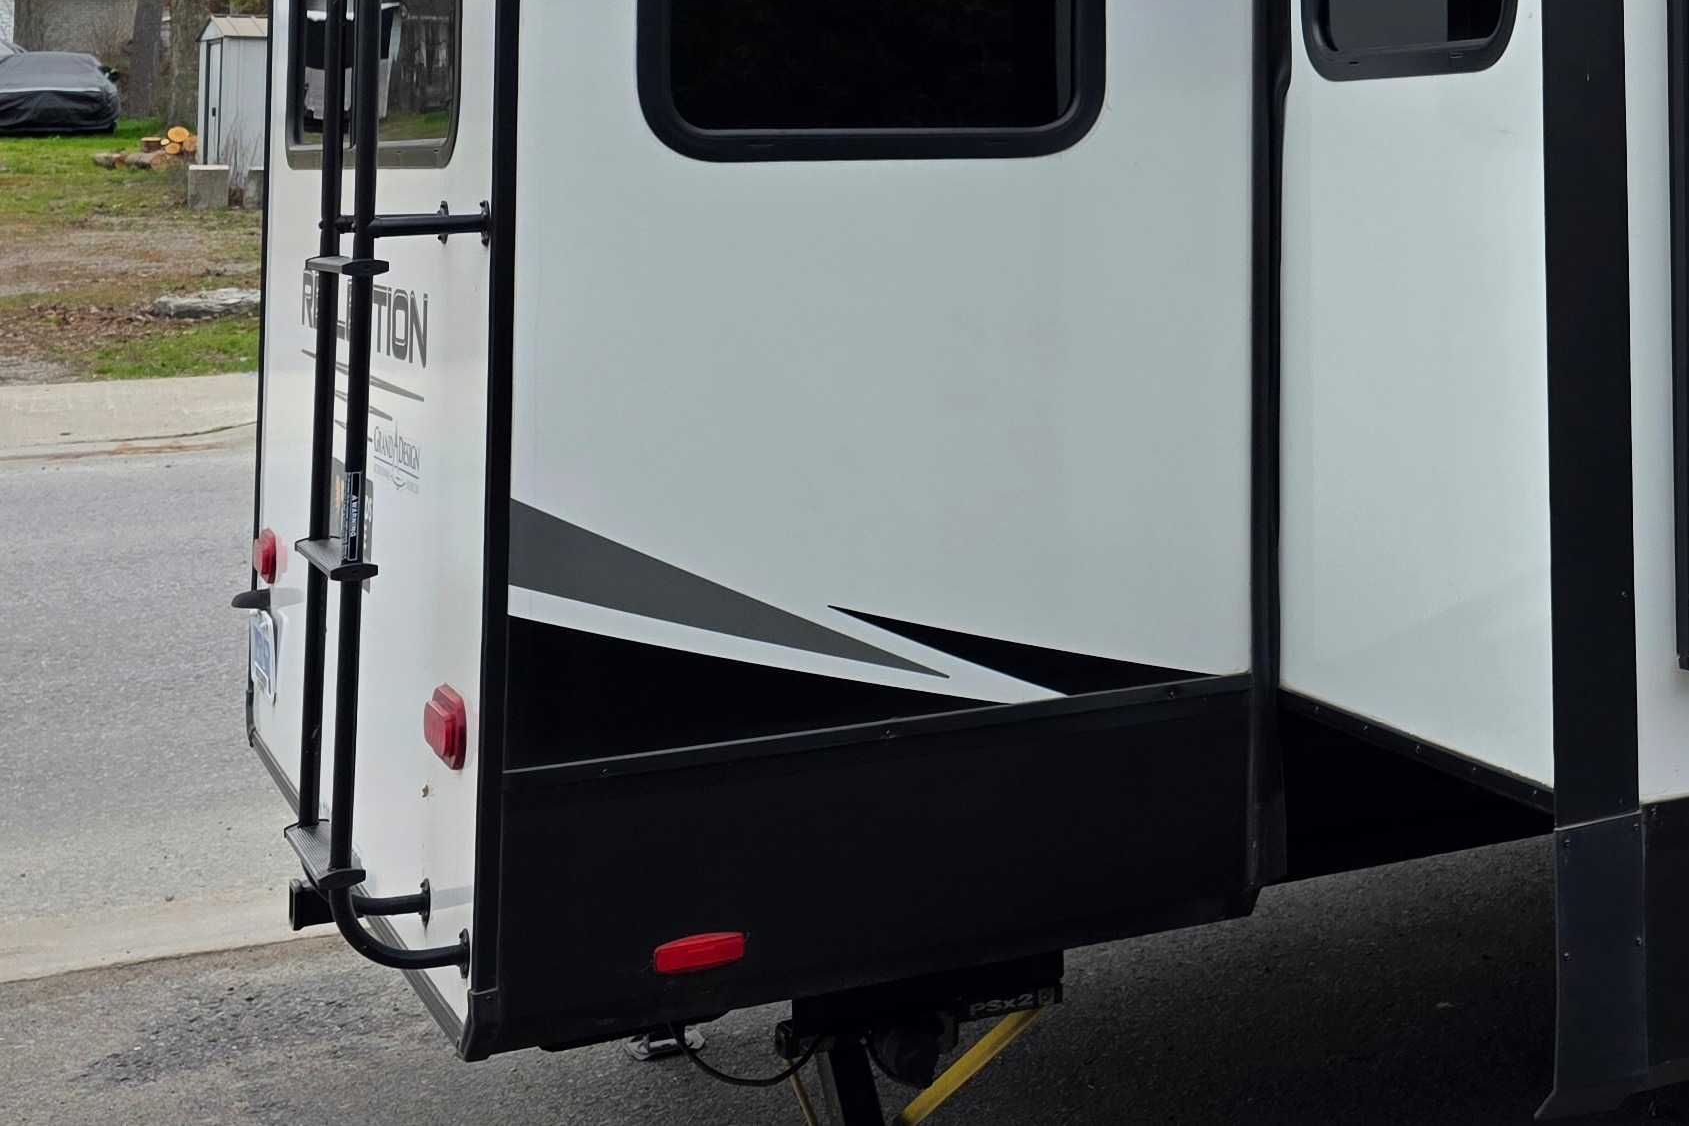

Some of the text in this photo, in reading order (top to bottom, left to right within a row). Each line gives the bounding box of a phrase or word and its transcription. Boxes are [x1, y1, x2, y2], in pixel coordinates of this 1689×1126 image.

[373, 425, 393, 459] GRAND
[398, 435, 420, 472] DESIGN
[349, 501, 358, 537] WARNING
